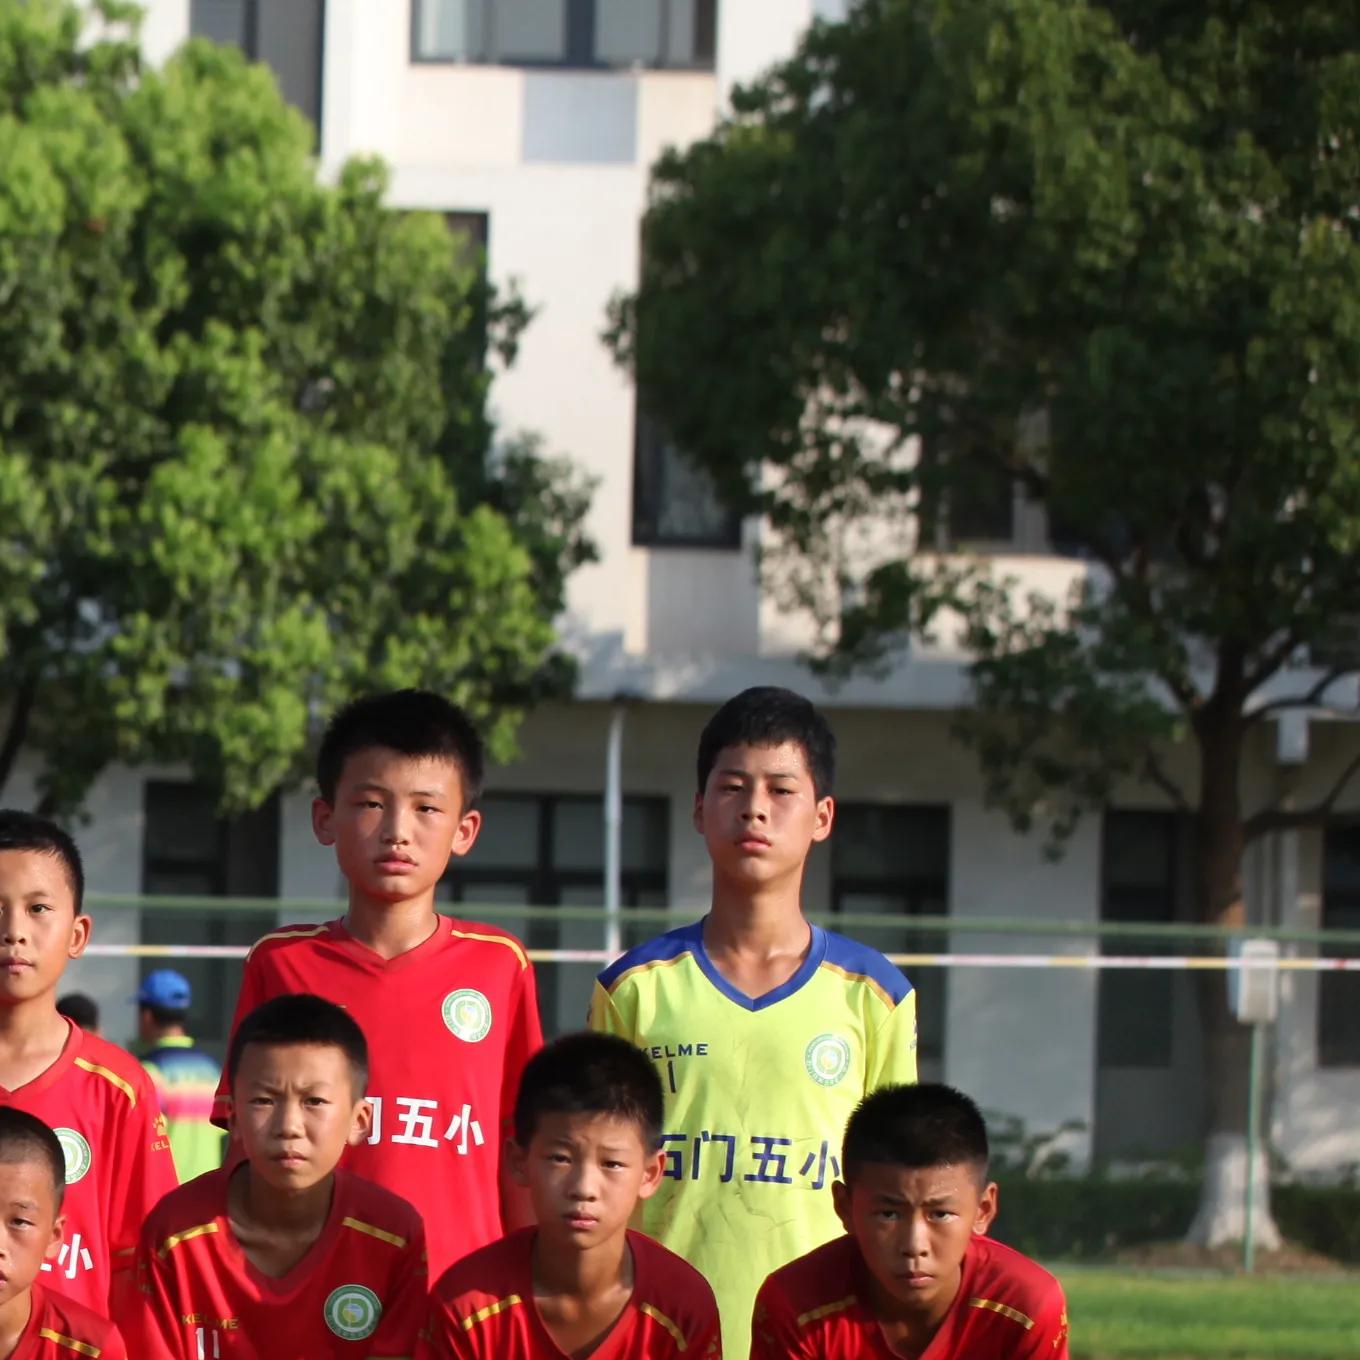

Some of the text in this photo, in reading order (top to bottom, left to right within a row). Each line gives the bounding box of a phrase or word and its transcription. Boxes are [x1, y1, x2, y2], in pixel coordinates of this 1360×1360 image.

[659, 1130, 840, 1190] 石门五小
[195, 1327, 221, 1360] 11
